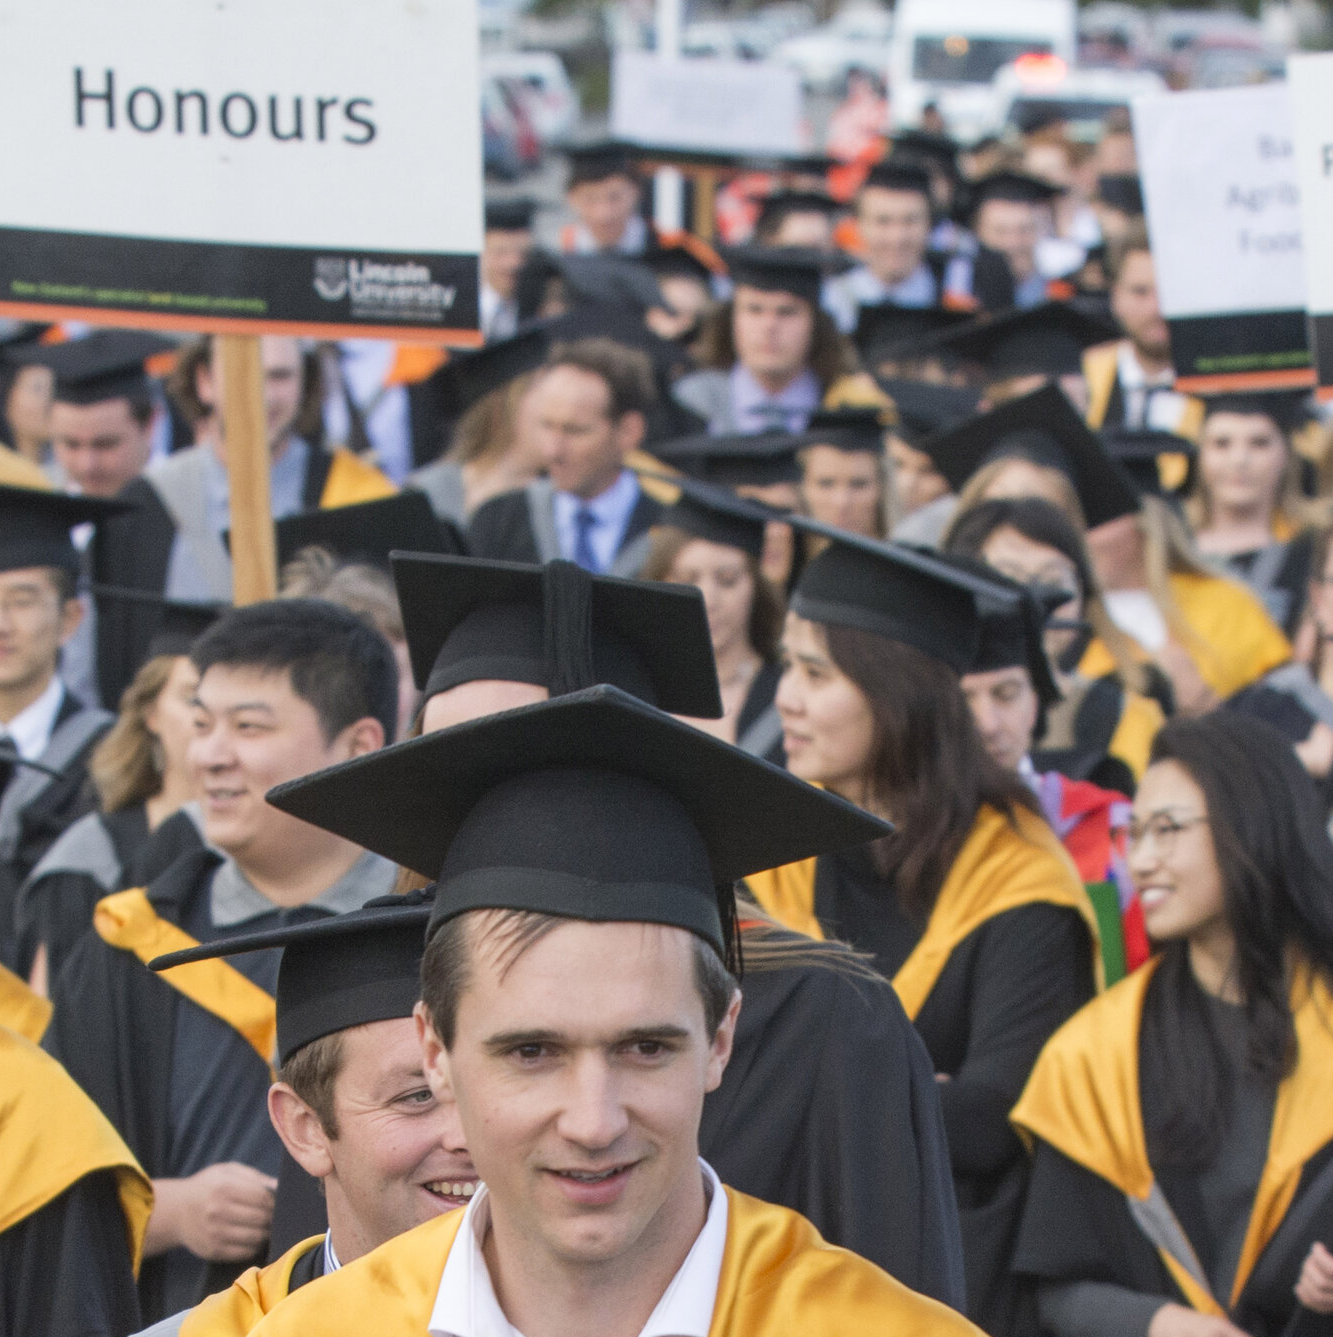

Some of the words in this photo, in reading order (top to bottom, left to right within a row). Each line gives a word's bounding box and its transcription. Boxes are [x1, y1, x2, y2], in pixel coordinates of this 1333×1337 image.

[73, 65, 378, 146] Honours
[348, 258, 431, 282] Lincoln
[349, 280, 457, 309] University
